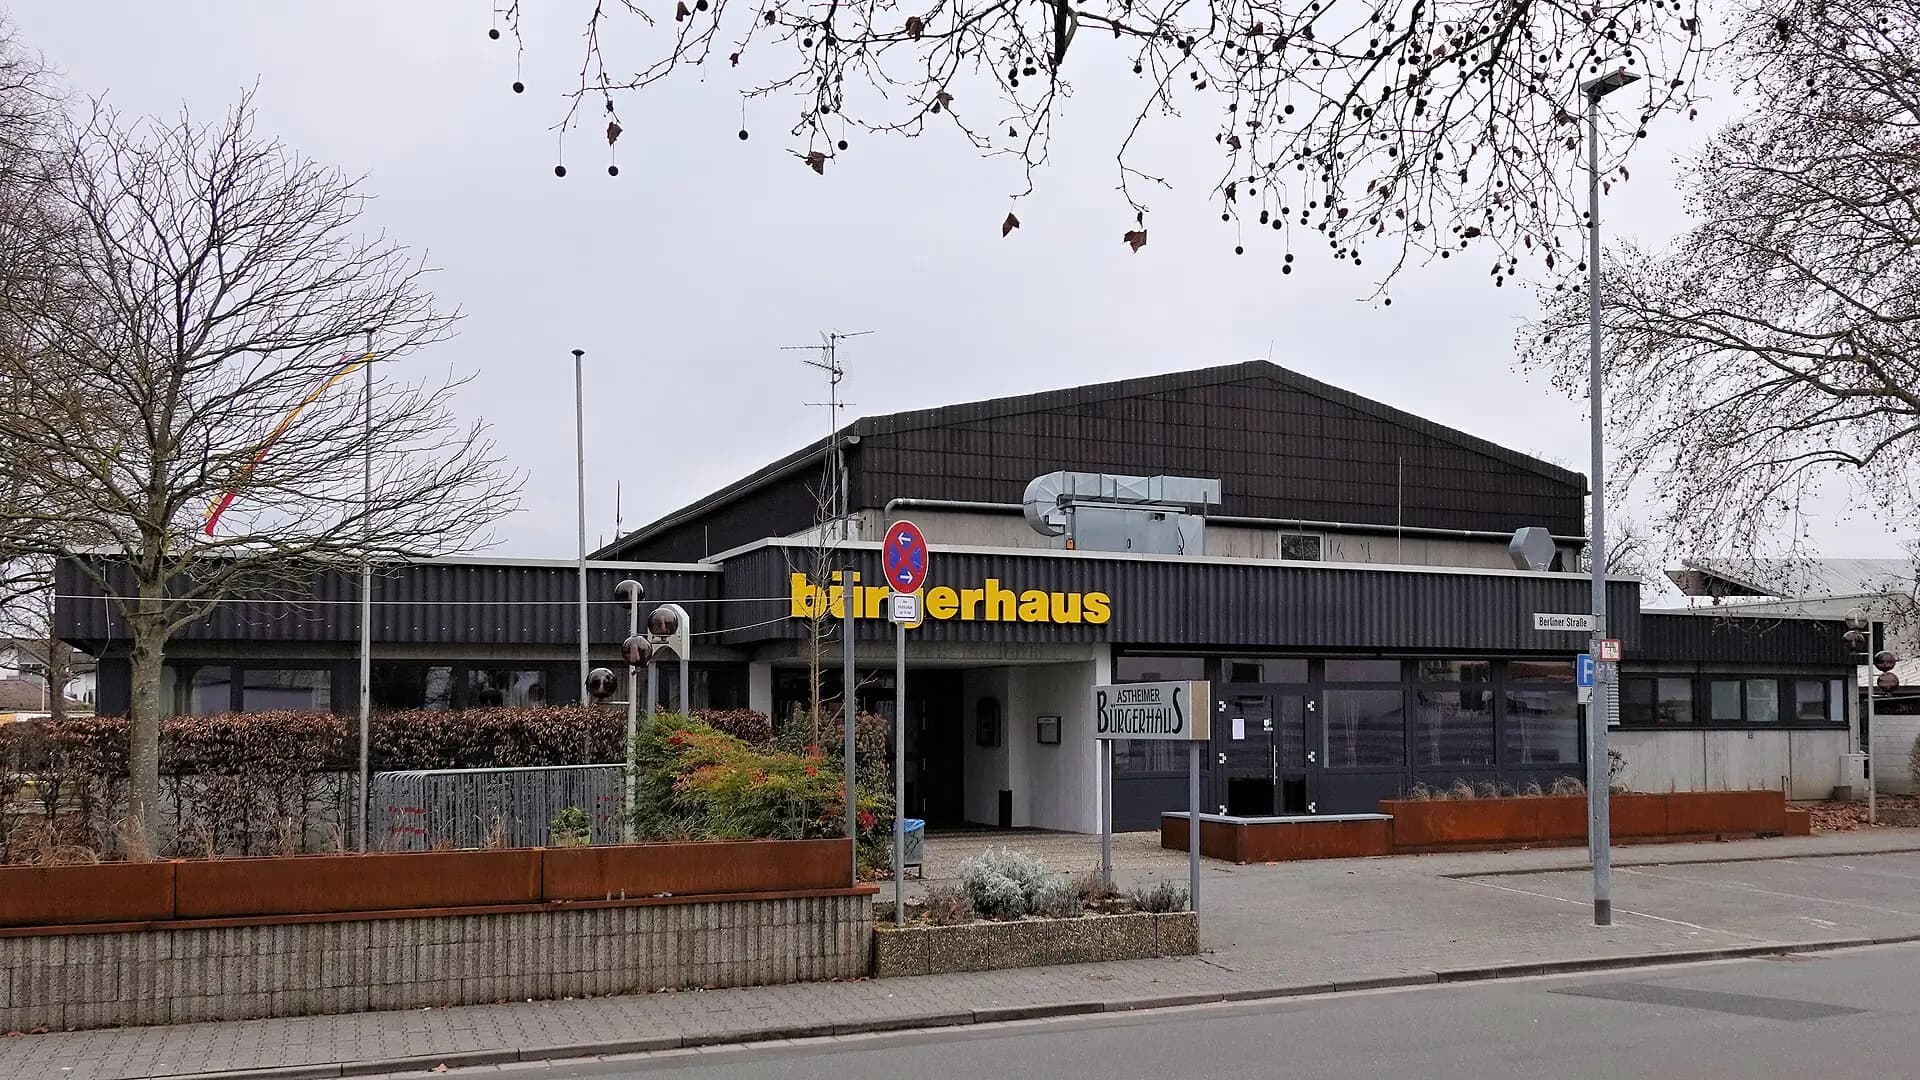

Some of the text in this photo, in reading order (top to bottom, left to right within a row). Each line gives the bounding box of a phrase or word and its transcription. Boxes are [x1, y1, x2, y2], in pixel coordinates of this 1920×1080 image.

[1539, 617, 1588, 627] Berliner Straße
[1117, 688, 1161, 703] ASTHEIMER
[1096, 687, 1184, 734] BÜRGERHAUS
